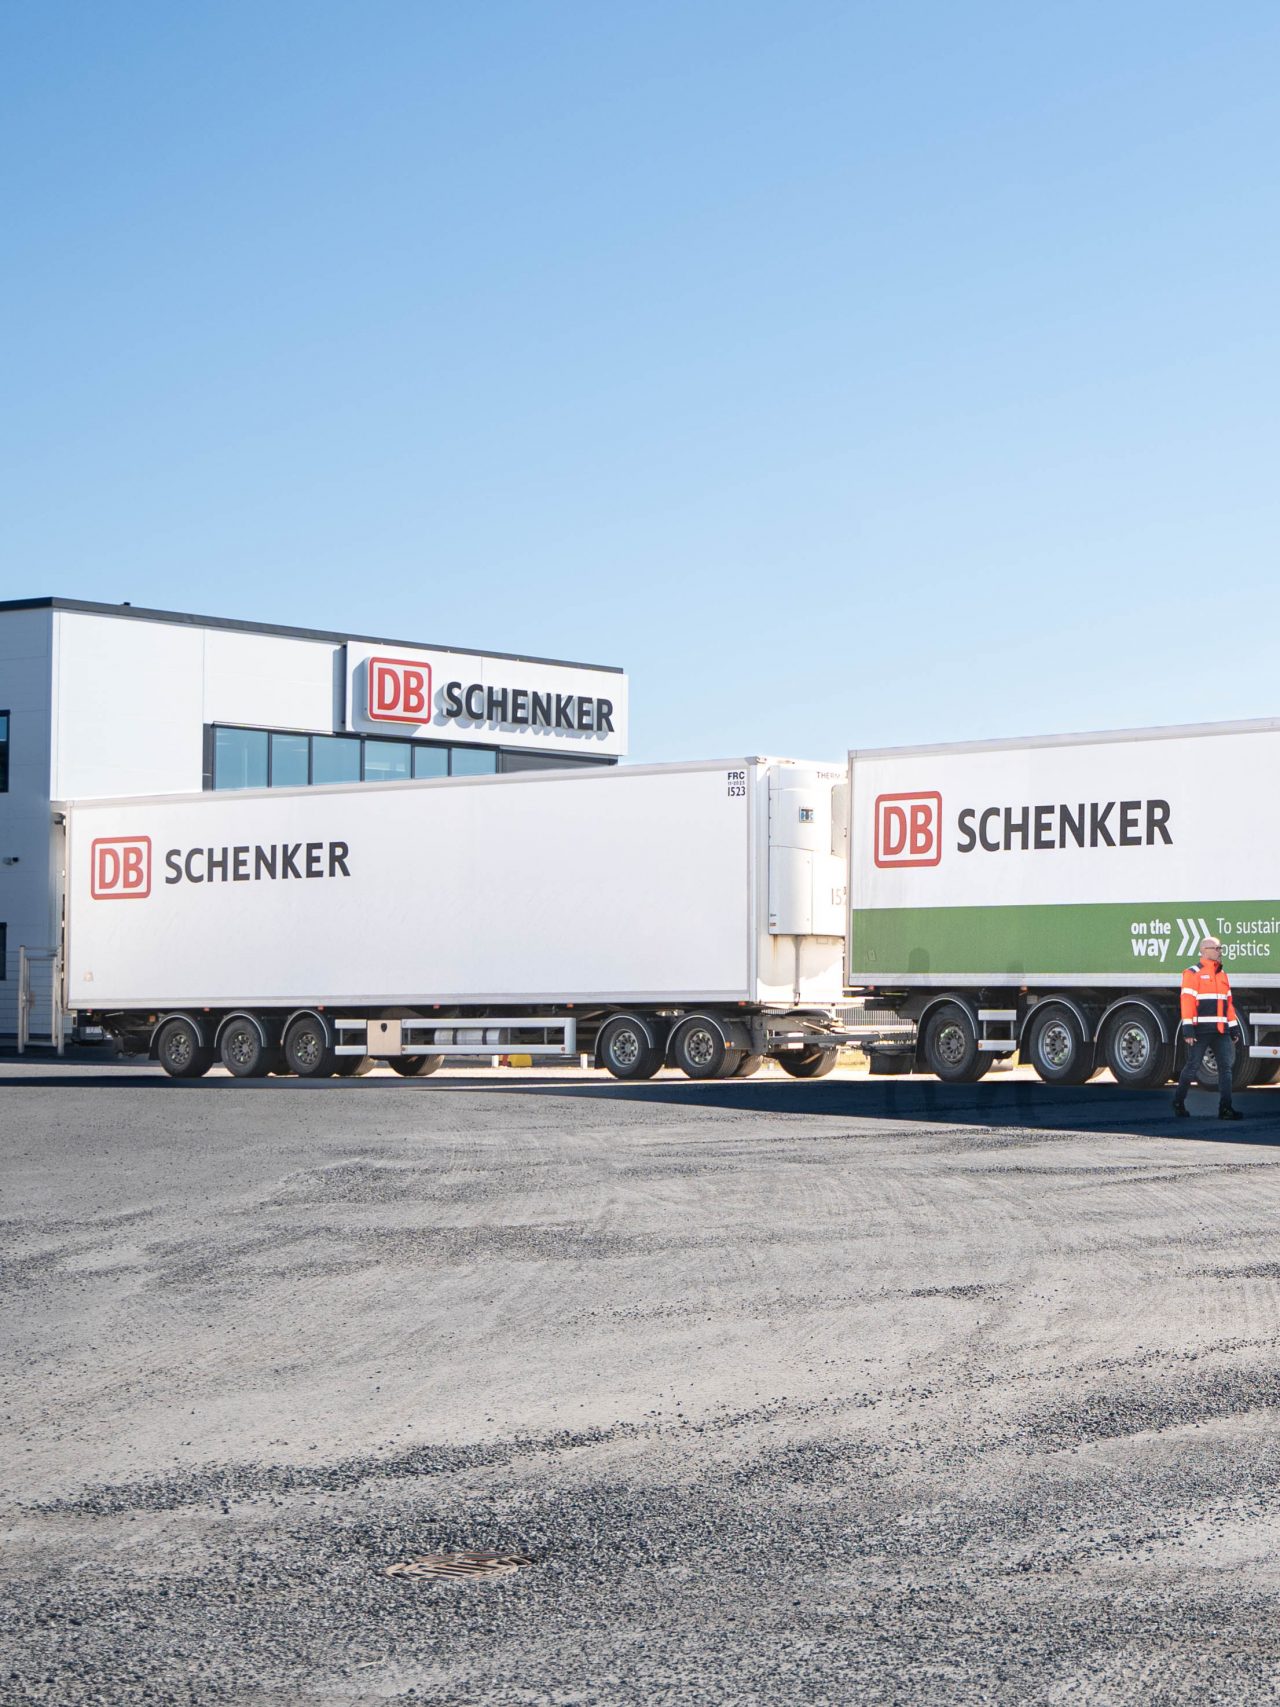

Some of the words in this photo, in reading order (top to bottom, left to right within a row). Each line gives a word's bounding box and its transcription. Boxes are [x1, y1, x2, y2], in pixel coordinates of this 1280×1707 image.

[377, 667, 425, 713] DB
[446, 681, 615, 733] SCHENKER
[727, 771, 745, 780] FRC
[727, 786, 746, 796] 1523
[883, 804, 934, 856] DB
[957, 799, 1174, 853] SCHENKER
[99, 846, 144, 889] DB
[165, 841, 352, 885] SCHENKER
[1131, 922, 1148, 935] on
[1150, 919, 1172, 935] the
[1216, 917, 1232, 934] To
[1131, 938, 1171, 963] way
[1220, 940, 1271, 960] ogistics
